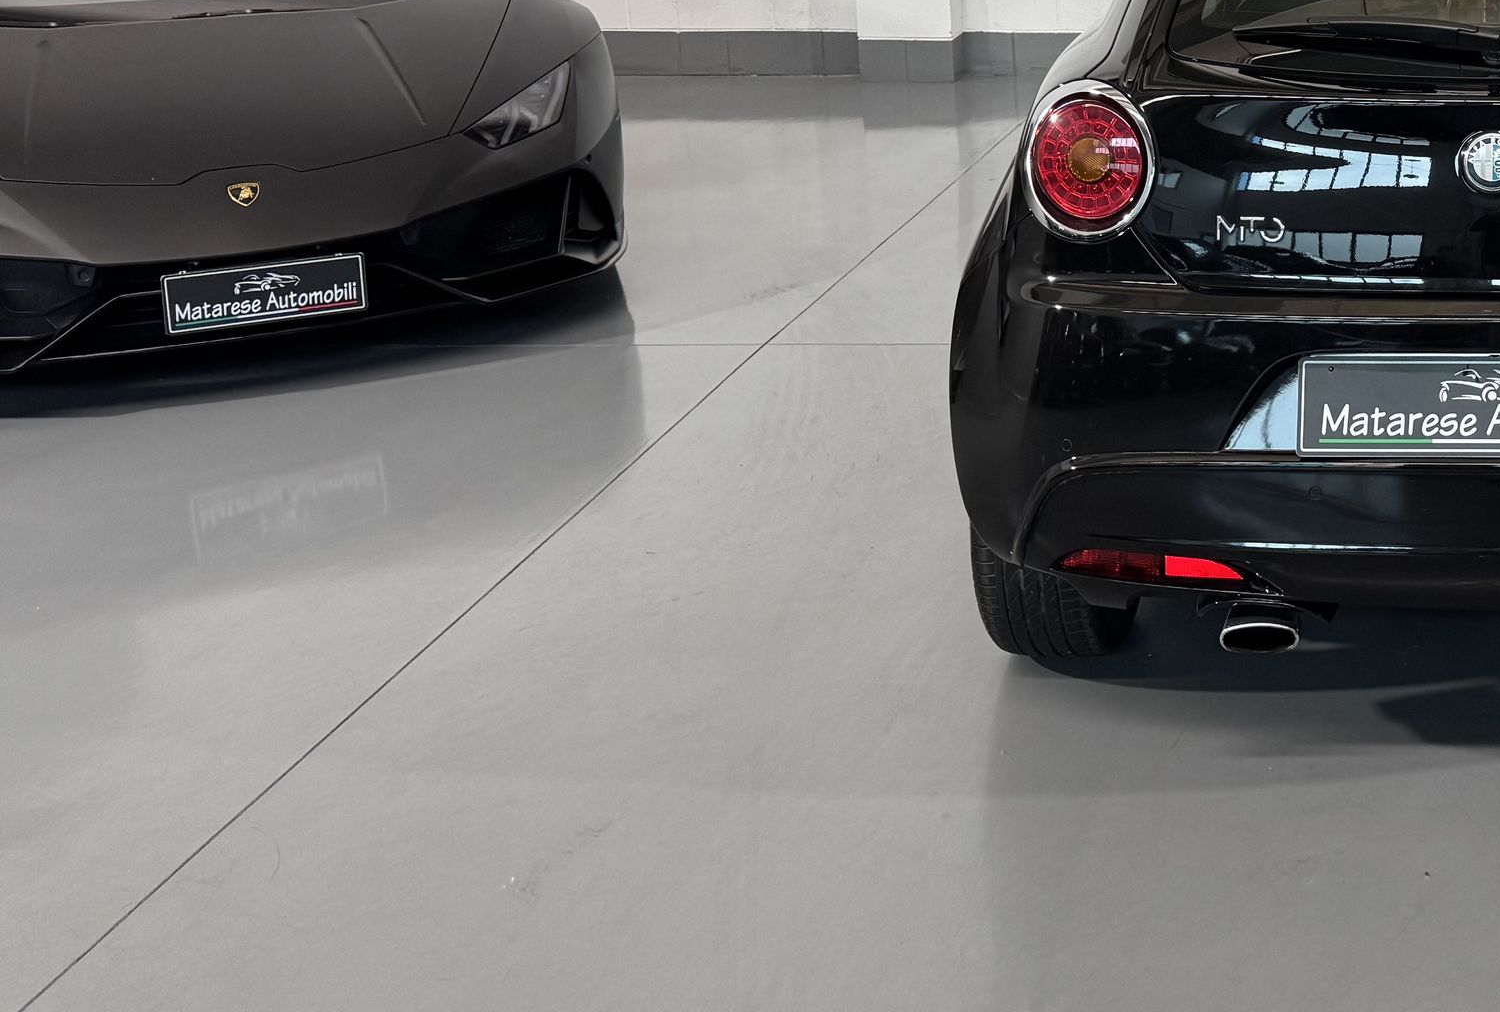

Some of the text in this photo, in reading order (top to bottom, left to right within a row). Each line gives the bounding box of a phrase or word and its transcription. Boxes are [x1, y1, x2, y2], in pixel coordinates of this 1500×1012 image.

[174, 281, 358, 323] Matarese Automobili
[1321, 403, 1478, 437] Matarese
